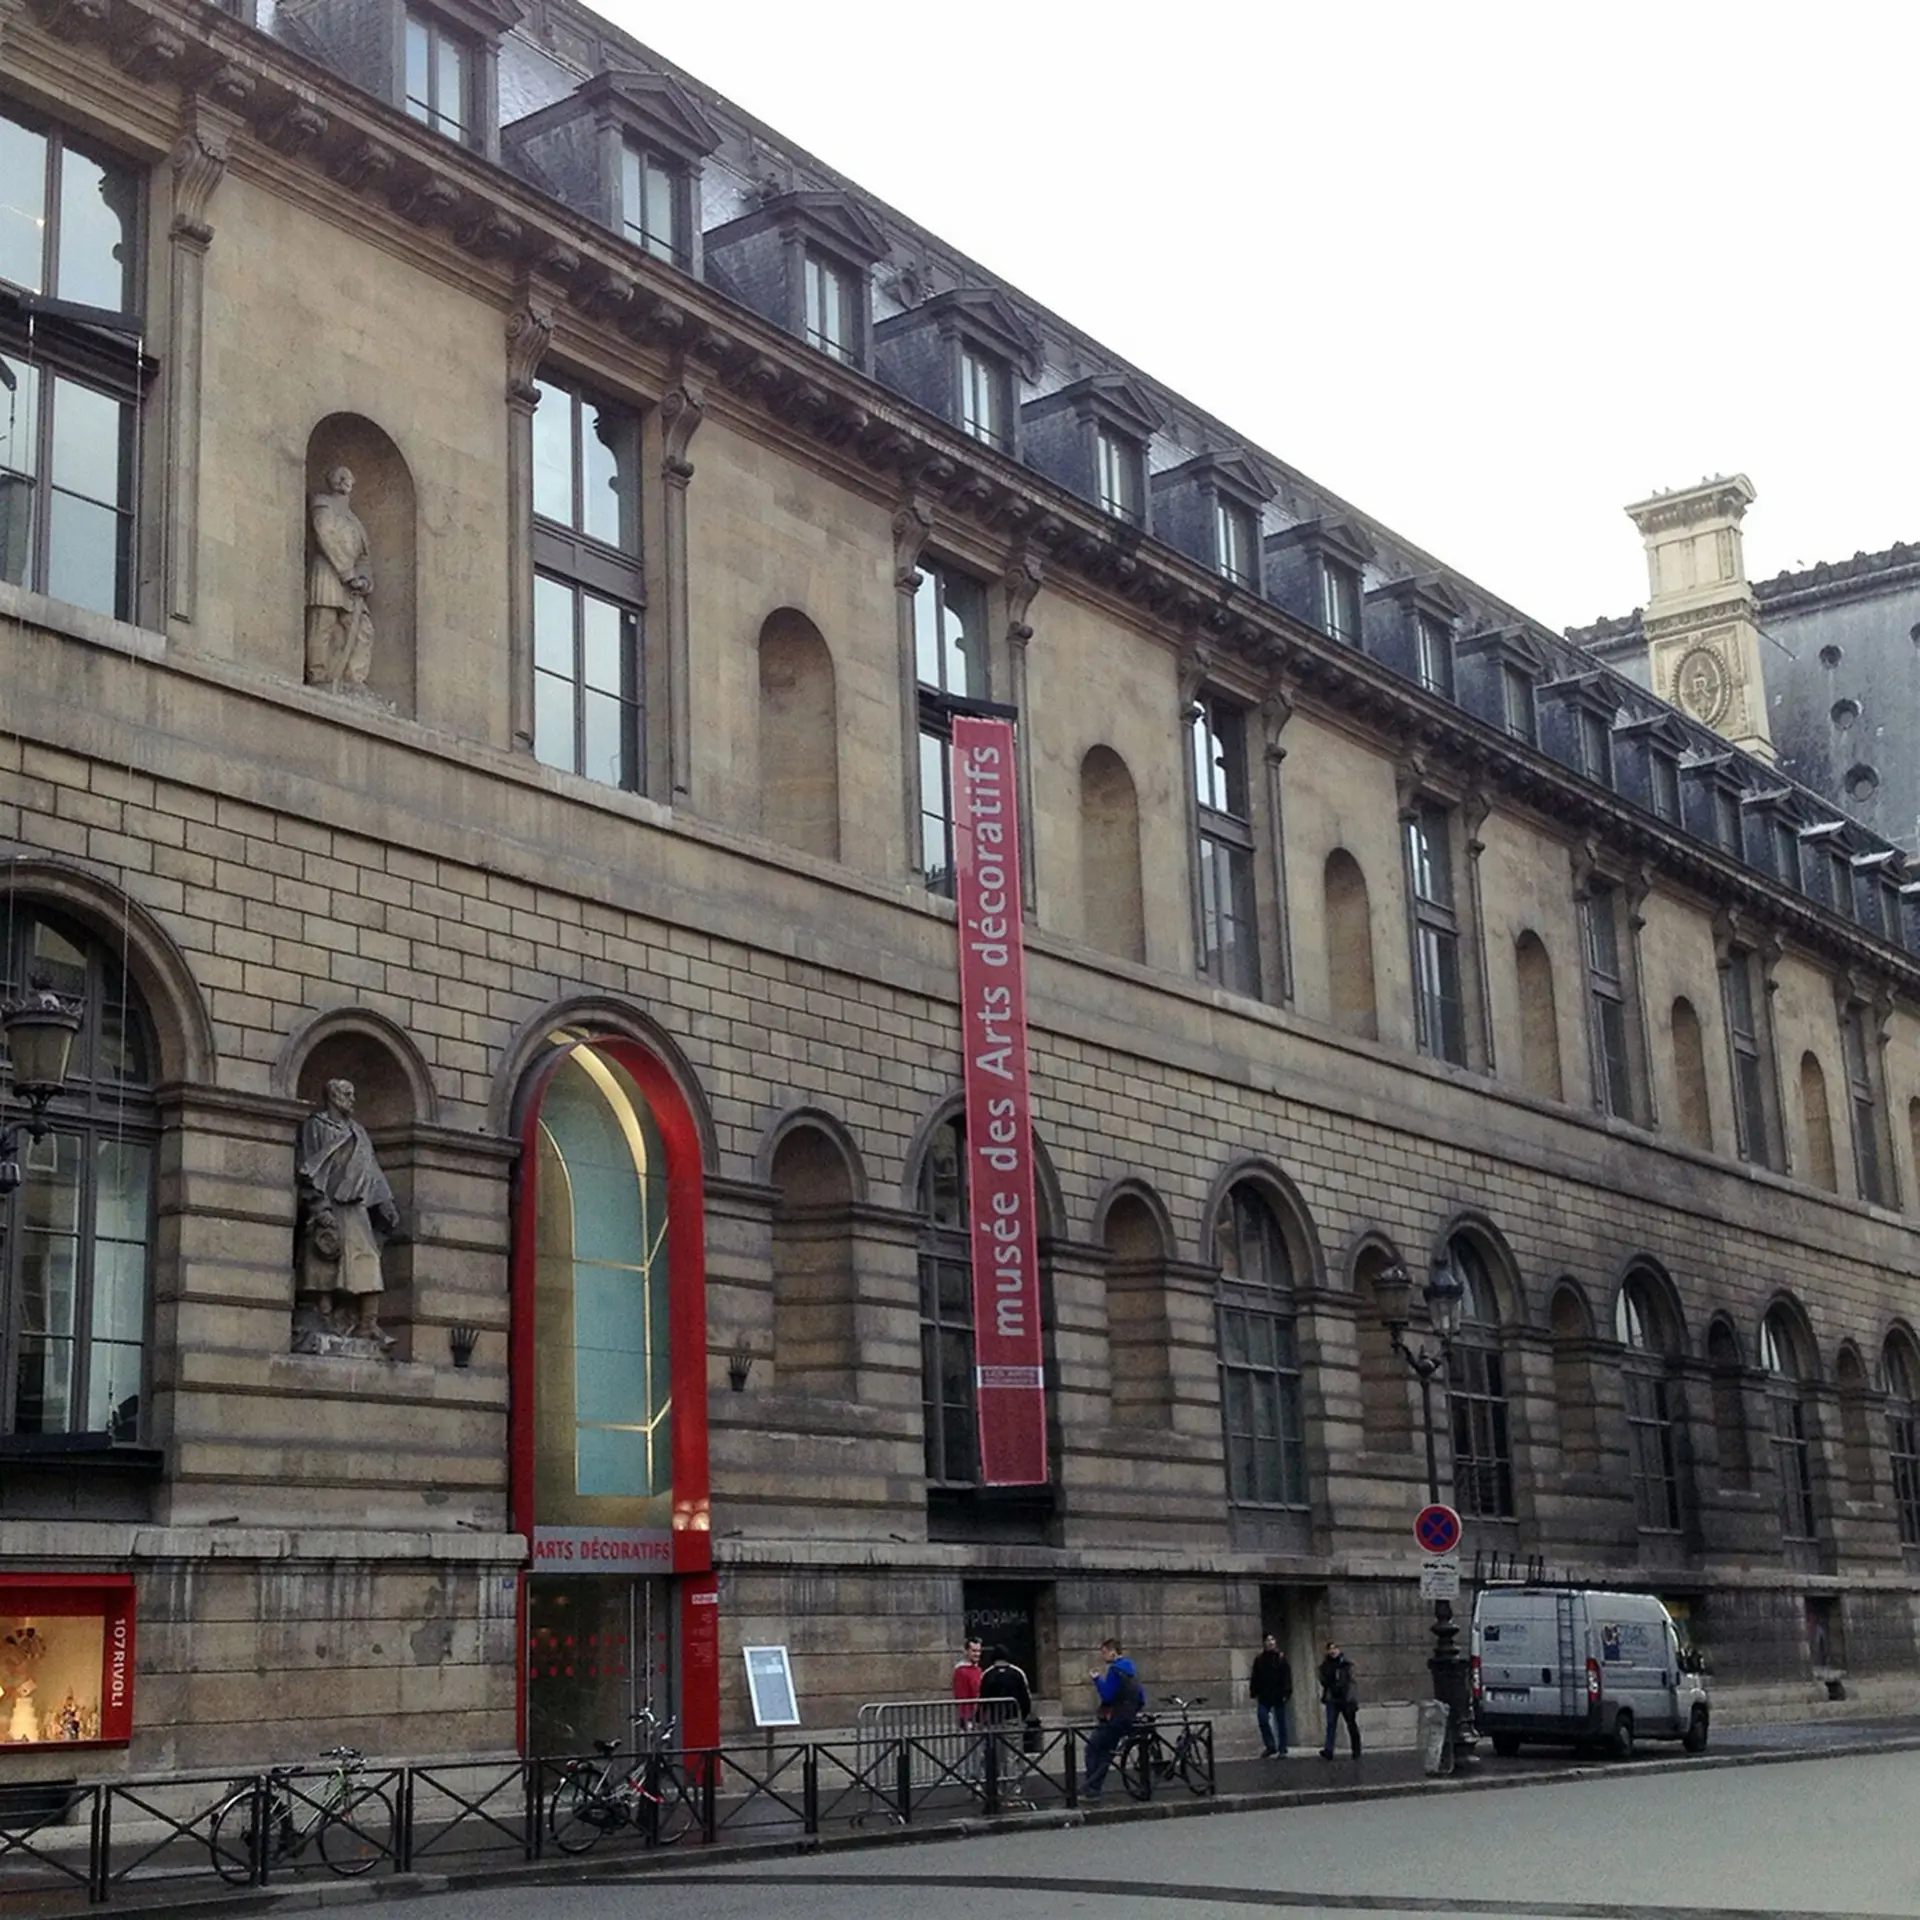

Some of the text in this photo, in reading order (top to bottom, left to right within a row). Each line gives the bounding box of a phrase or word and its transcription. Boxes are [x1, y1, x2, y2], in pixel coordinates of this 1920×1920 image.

[964, 745, 1007, 967] décoratifs
[976, 986, 1014, 1082] Arts
[979, 1098, 1019, 1172] des
[981, 1191, 1025, 1338] musée
[534, 1535, 670, 1560] ARTS DÉCORATIFS
